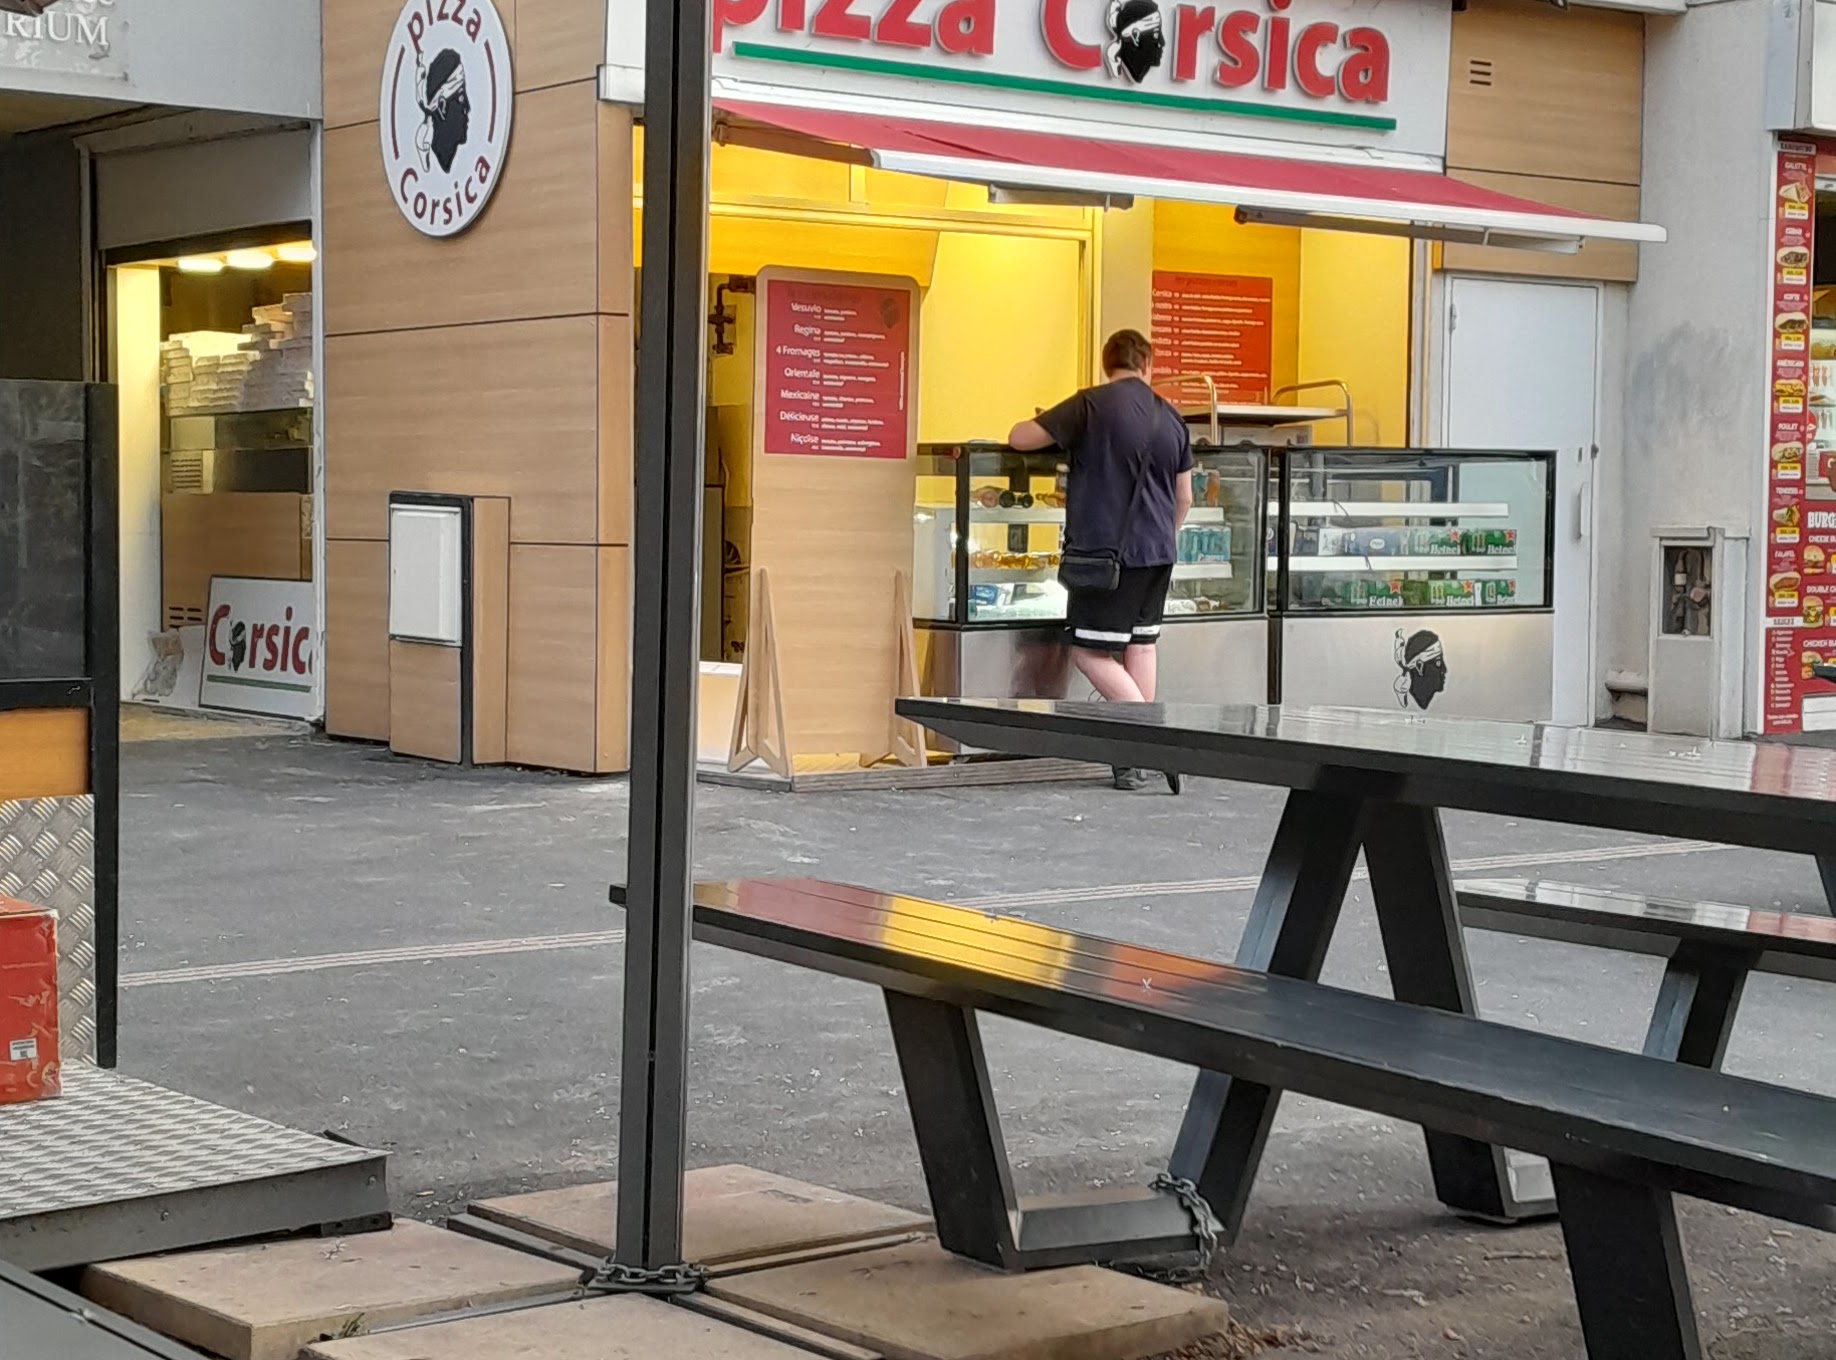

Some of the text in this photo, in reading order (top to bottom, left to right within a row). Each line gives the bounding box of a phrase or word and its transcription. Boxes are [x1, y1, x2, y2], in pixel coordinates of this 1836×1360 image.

[400, 155, 491, 225] Corsica
[791, 302, 821, 313] Vesuvio
[794, 324, 821, 336] Regina
[776, 346, 821, 358] 4 Fromages
[784, 367, 820, 378] Orientale
[781, 389, 820, 400] Mexicaine
[209, 604, 312, 674] Corsic
